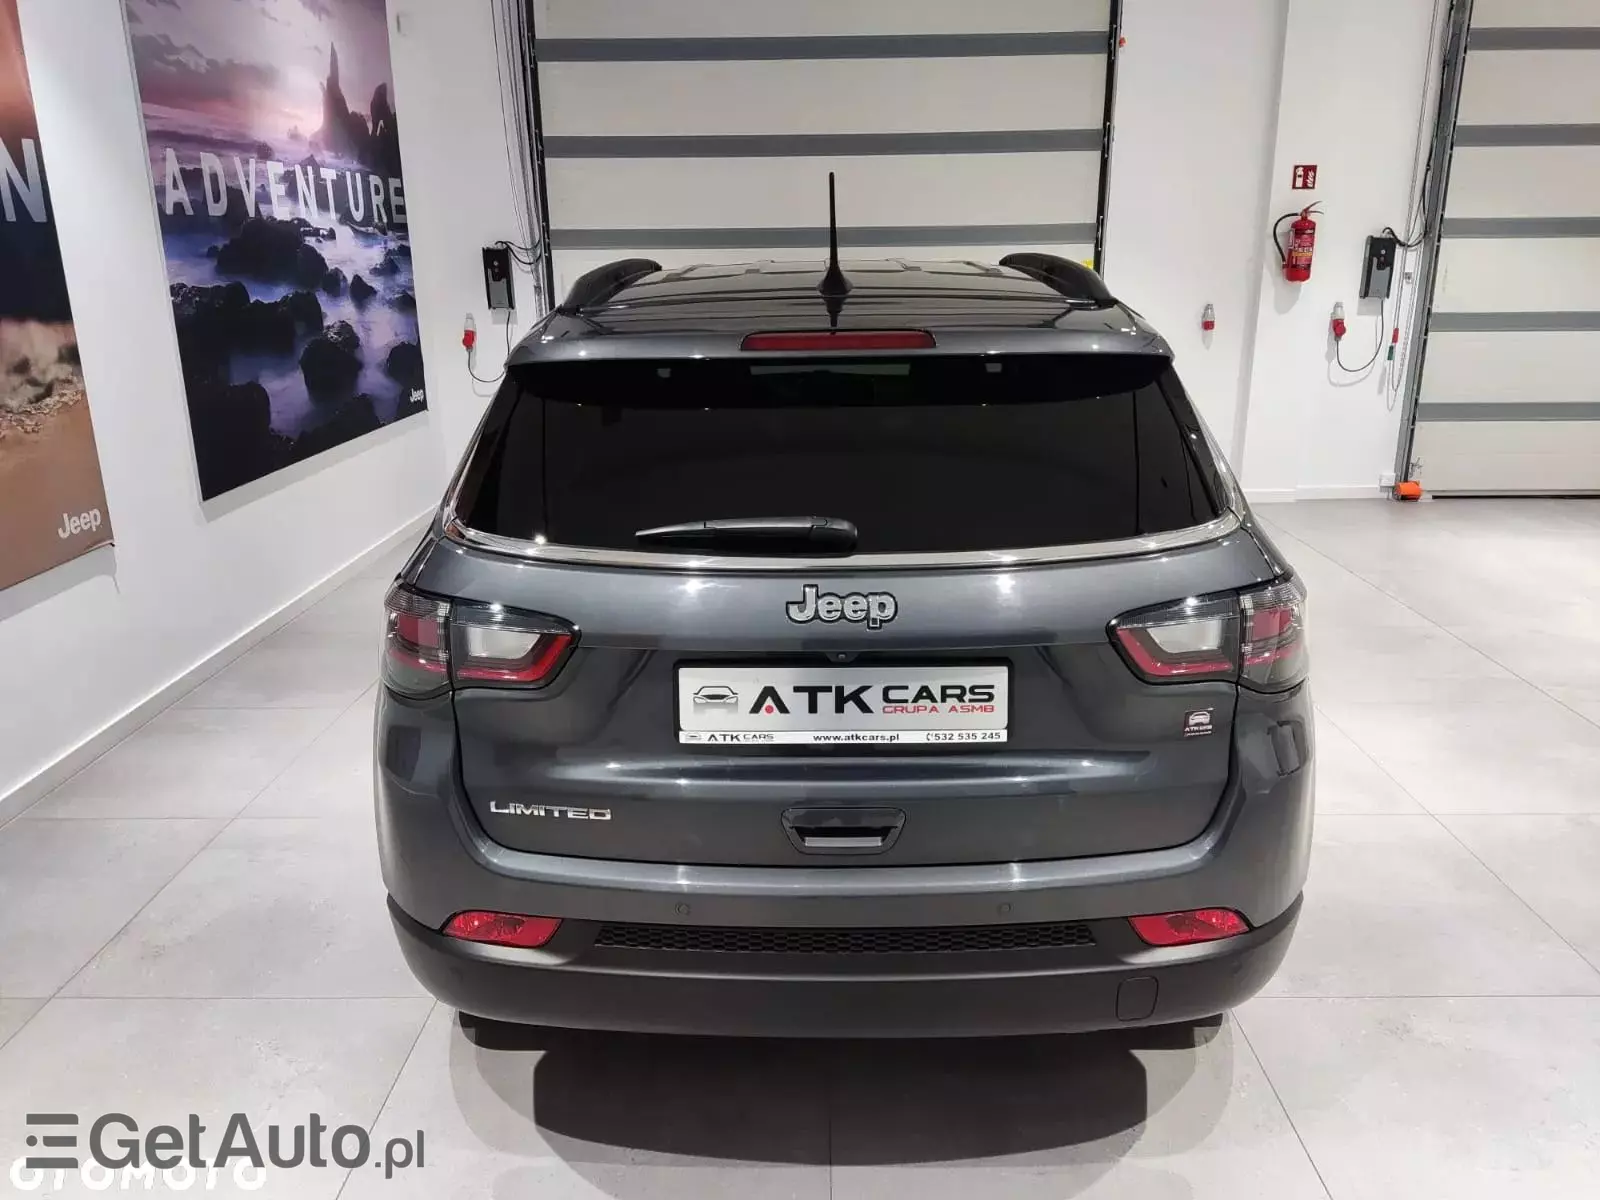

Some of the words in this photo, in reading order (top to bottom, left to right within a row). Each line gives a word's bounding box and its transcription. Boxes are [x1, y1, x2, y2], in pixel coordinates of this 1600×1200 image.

[164, 148, 408, 224] ADVENTURE
[57, 507, 102, 539] Jeep
[786, 584, 898, 629] Jeep
[749, 685, 874, 714] ATK
[882, 685, 995, 703] CARS
[882, 705, 939, 714] GRUPA
[948, 705, 995, 714] ASMB
[707, 733, 740, 742] ATK
[812, 733, 900, 742] www.atkcars.pl
[957, 732, 978, 741] 535
[981, 732, 1001, 741] 245
[490, 801, 611, 820] LIMITED
